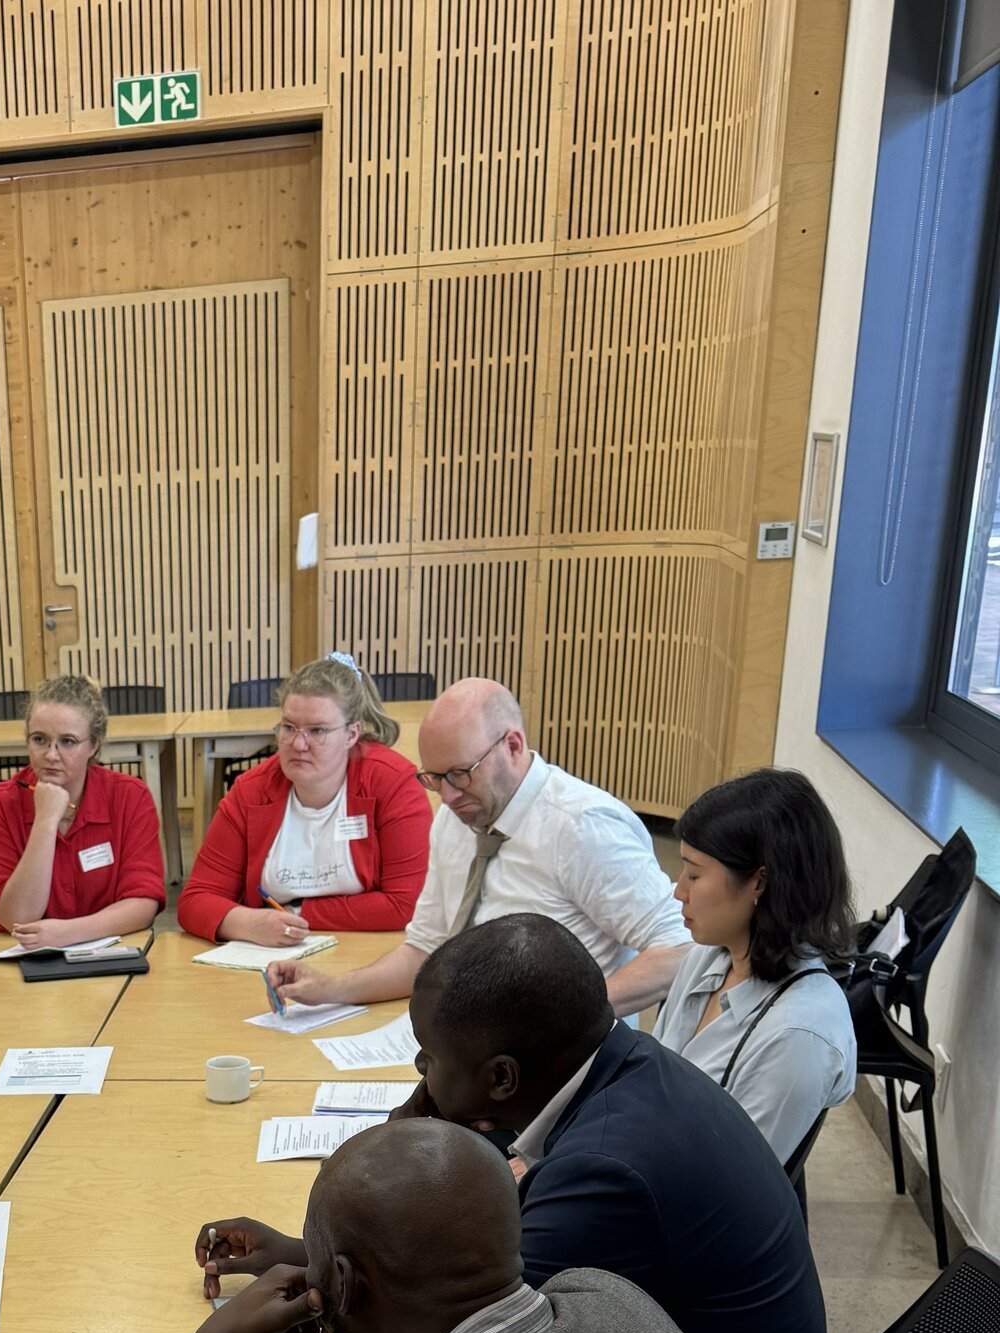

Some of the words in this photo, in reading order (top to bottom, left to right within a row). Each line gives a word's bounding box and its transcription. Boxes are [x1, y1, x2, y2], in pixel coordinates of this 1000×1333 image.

[275, 867, 297, 885] Be
[297, 868, 315, 884] the
[317, 863, 345, 882] light
